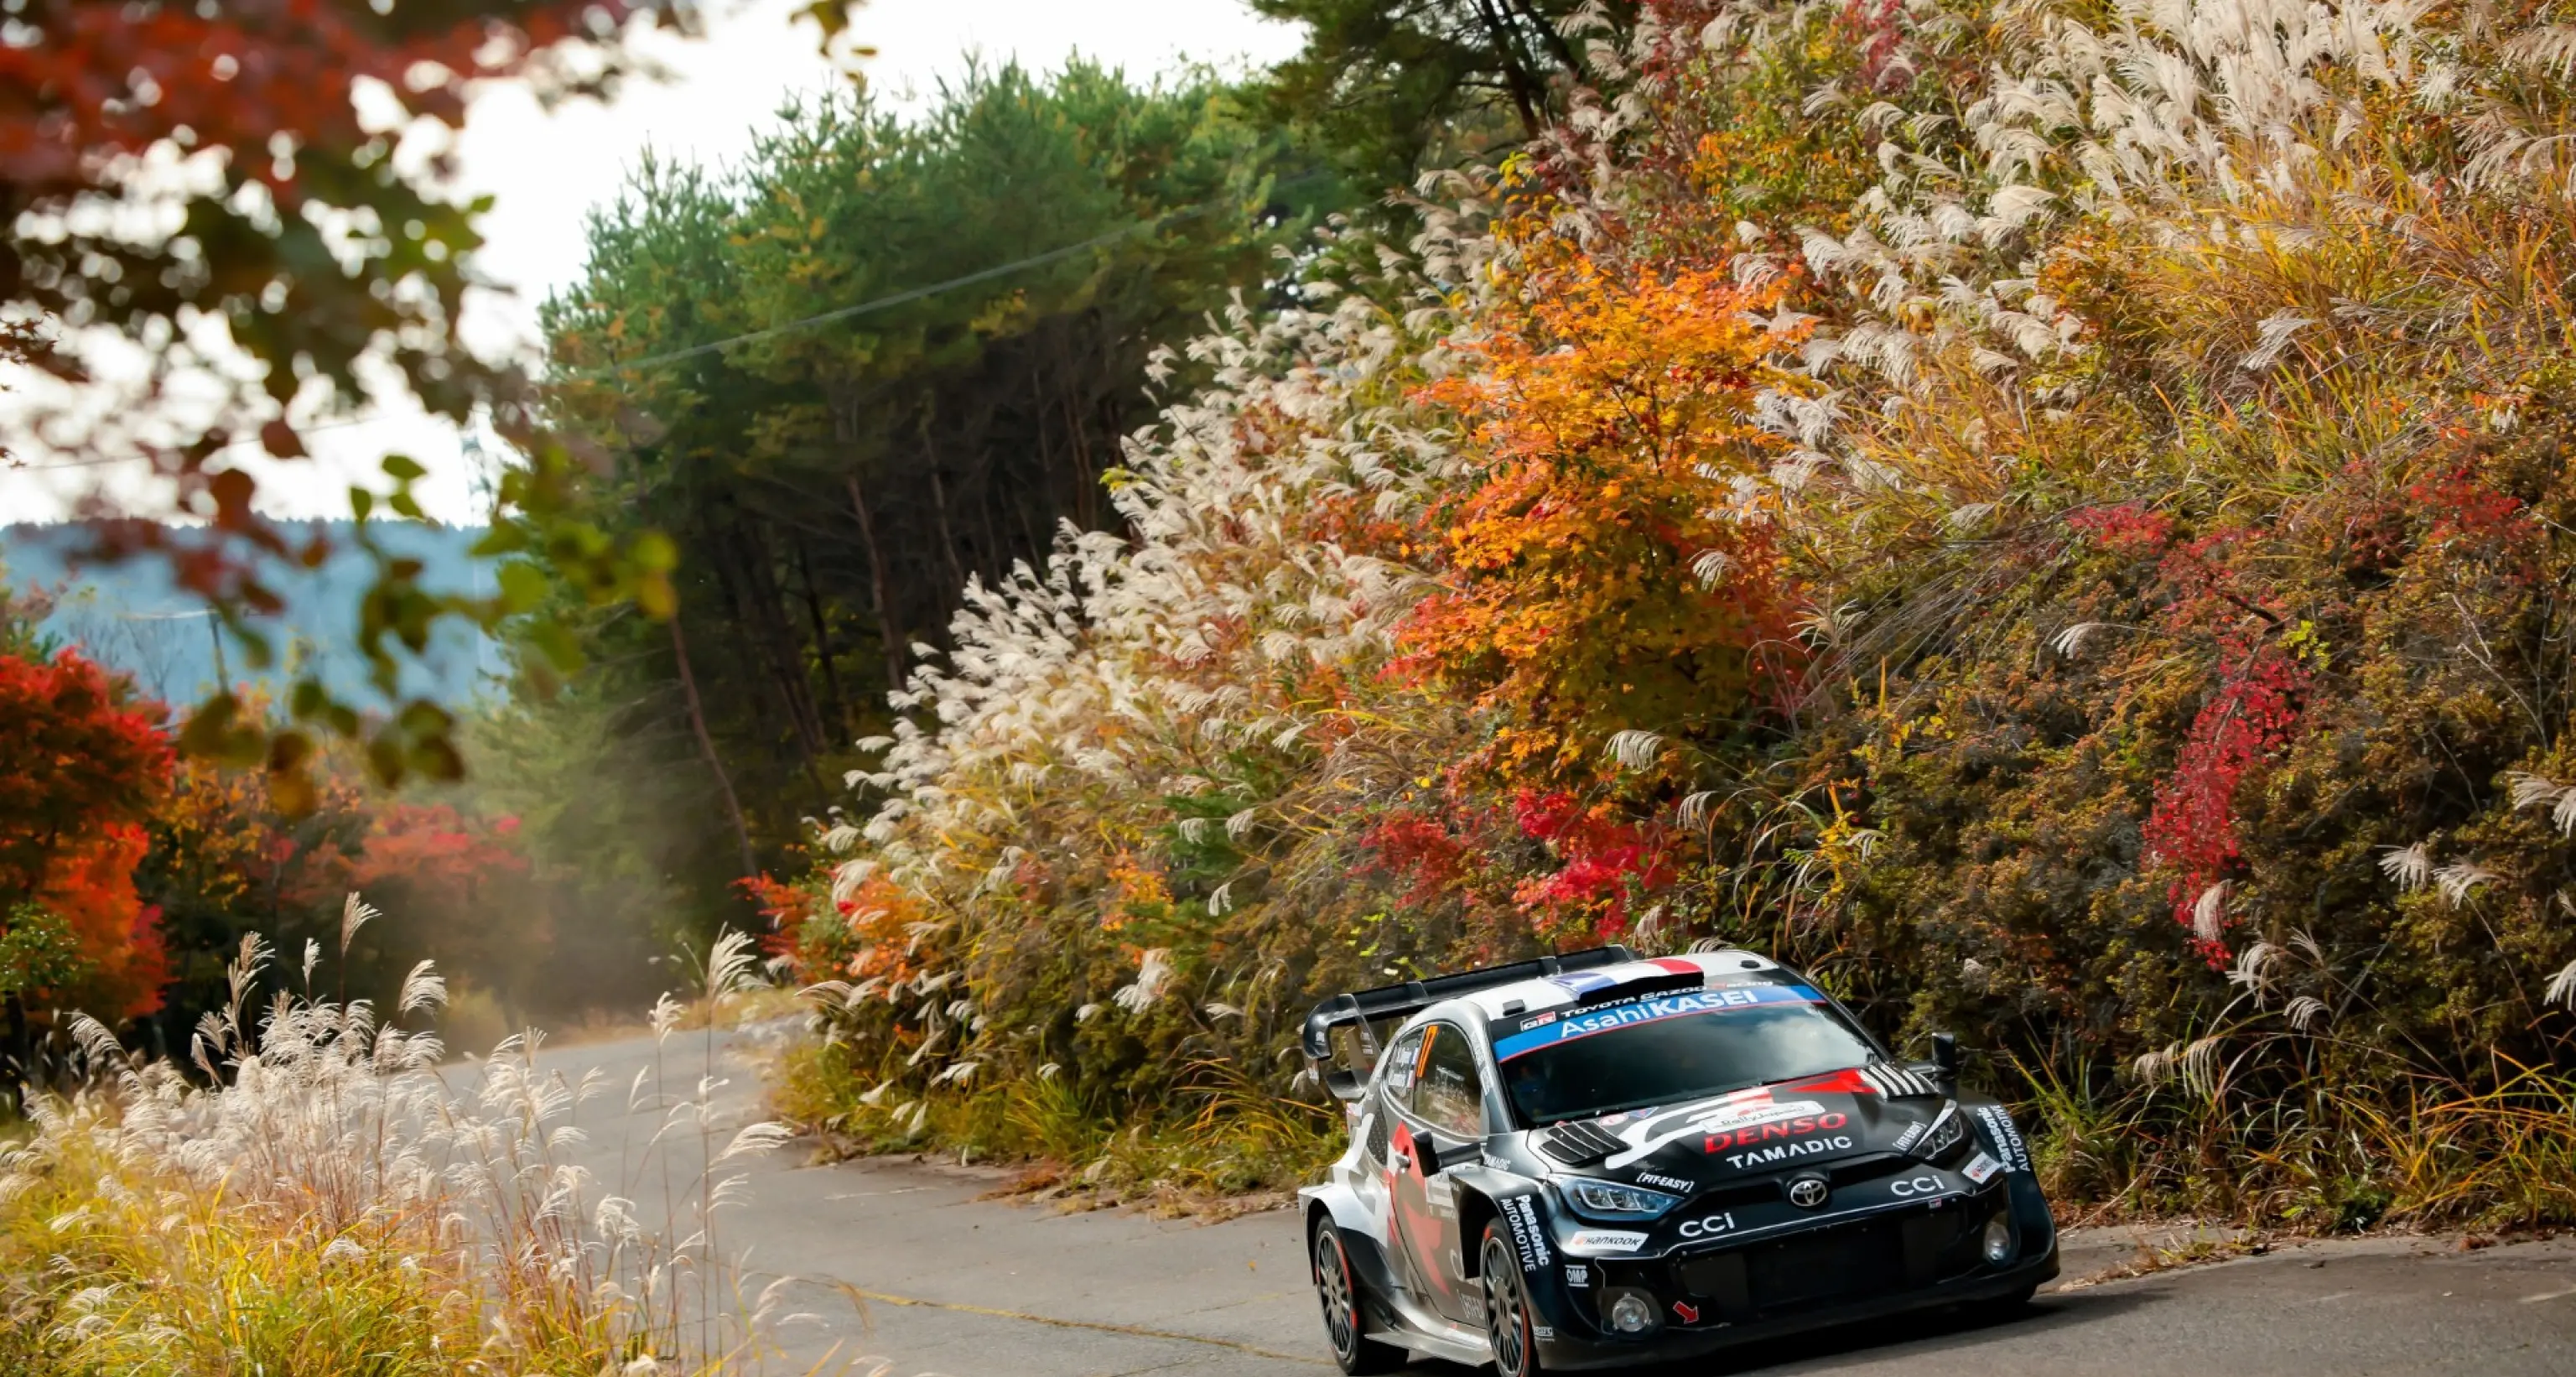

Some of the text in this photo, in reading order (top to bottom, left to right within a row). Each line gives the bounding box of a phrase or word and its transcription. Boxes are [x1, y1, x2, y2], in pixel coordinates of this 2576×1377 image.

[1561, 995, 1636, 1017] TOYOTA
[1561, 990, 1758, 1038] AsahiKASEI
[1704, 1112, 1848, 1156] DENSO
[1726, 1135, 1853, 1170] TAMADIC
[1976, 1106, 2017, 1173] Panasonic
[1499, 1198, 1537, 1273] AUTOMOTIVE
[1514, 1193, 1550, 1267] Panasonic
[1566, 1268, 1589, 1285] OMP
